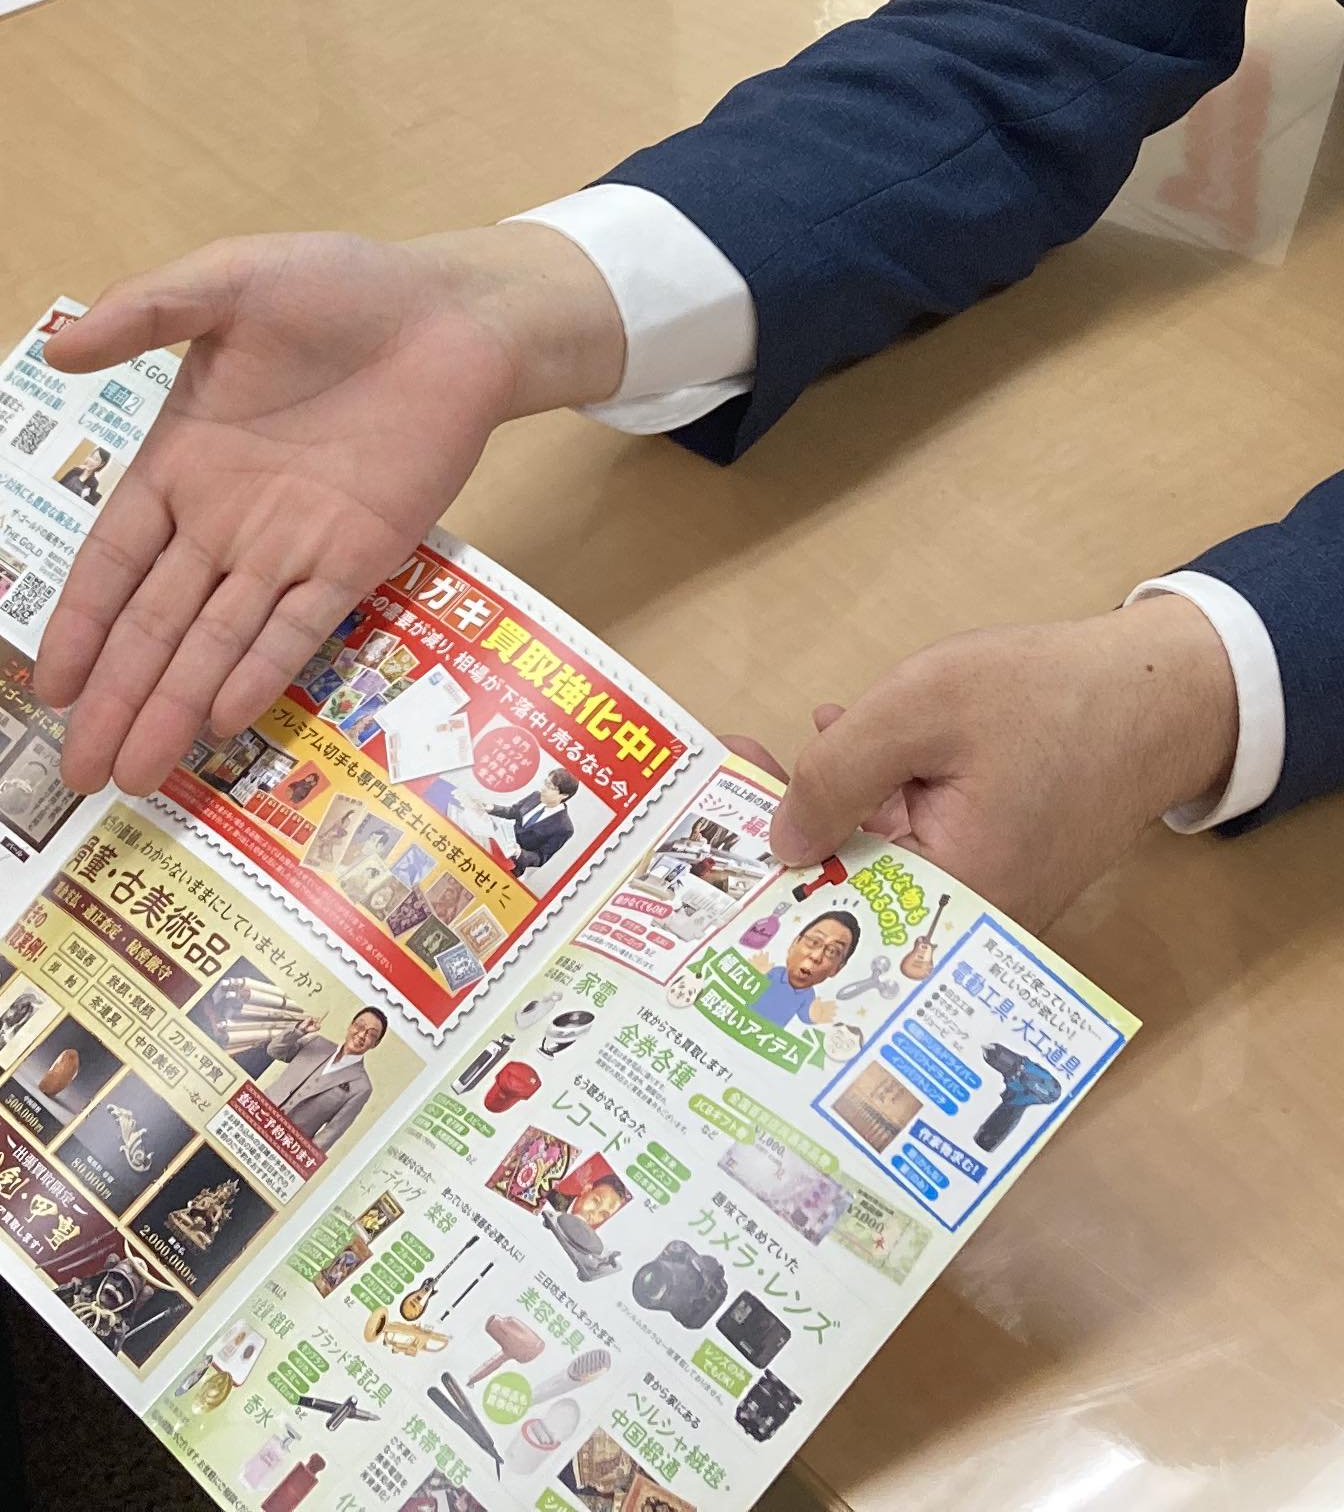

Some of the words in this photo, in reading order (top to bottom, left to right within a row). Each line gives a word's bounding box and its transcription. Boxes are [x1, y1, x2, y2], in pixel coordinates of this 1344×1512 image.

[1, 523, 21, 542] THE
[16, 534, 45, 559] GOLD
[474, 614, 679, 781] 買取強化中!
[871, 854, 930, 925] こんな物も
[572, 967, 619, 1011] 家電
[718, 951, 762, 996] 幅広い
[982, 962, 1083, 1041] 新しいのが欲しい!
[85, 994, 125, 1028] 茶道具
[127, 1033, 184, 1082] 中国美術
[611, 1018, 700, 1092] 金券各種
[634, 1004, 735, 1083] 1枚からでも買取します!
[700, 989, 803, 1064] 取扱いアイテム
[939, 960, 1091, 1080] 電動工具・大工道具
[227, 1089, 325, 1171] 査定ご予約承ります
[547, 1089, 632, 1160] レコード
[7, 1144, 81, 1207] 出張買取限定
[421, 1200, 460, 1235] 楽器
[703, 1190, 807, 1274] 趣味で集めていた
[688, 1208, 843, 1346] カメラ・レンズ
[509, 1285, 593, 1355] 美容器具
[299, 1324, 401, 1408] ブランド筆記具
[636, 1370, 709, 1429] 昔から家にある
[240, 1392, 278, 1429] 香水
[597, 1404, 691, 1483] 中国緞通
[392, 1412, 482, 1488] 携帯電話
